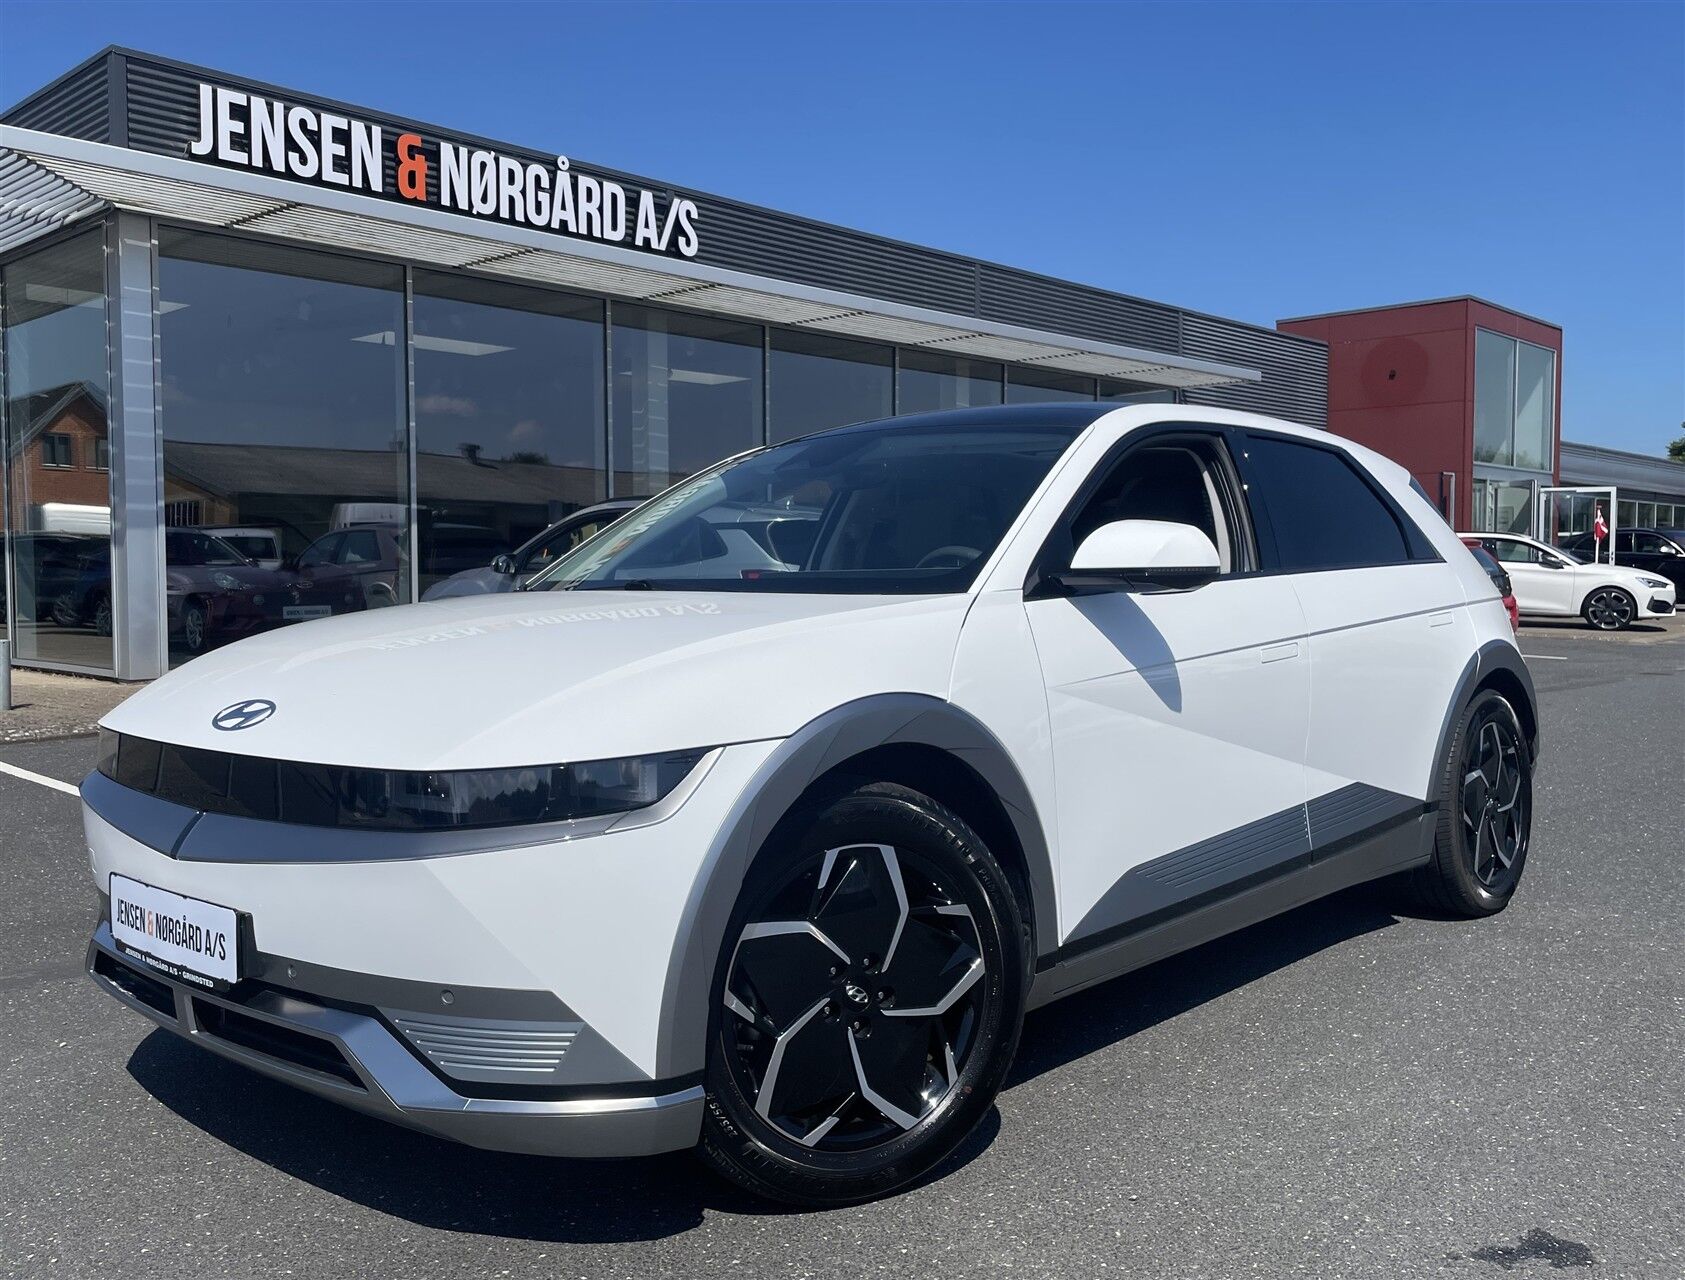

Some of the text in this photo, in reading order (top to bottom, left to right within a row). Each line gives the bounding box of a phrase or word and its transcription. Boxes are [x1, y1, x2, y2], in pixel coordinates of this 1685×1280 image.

[190, 83, 699, 257] JENSEN & NØRGÅRD A/S
[117, 898, 226, 961] JENSEN & NØRGÅRD A/S
